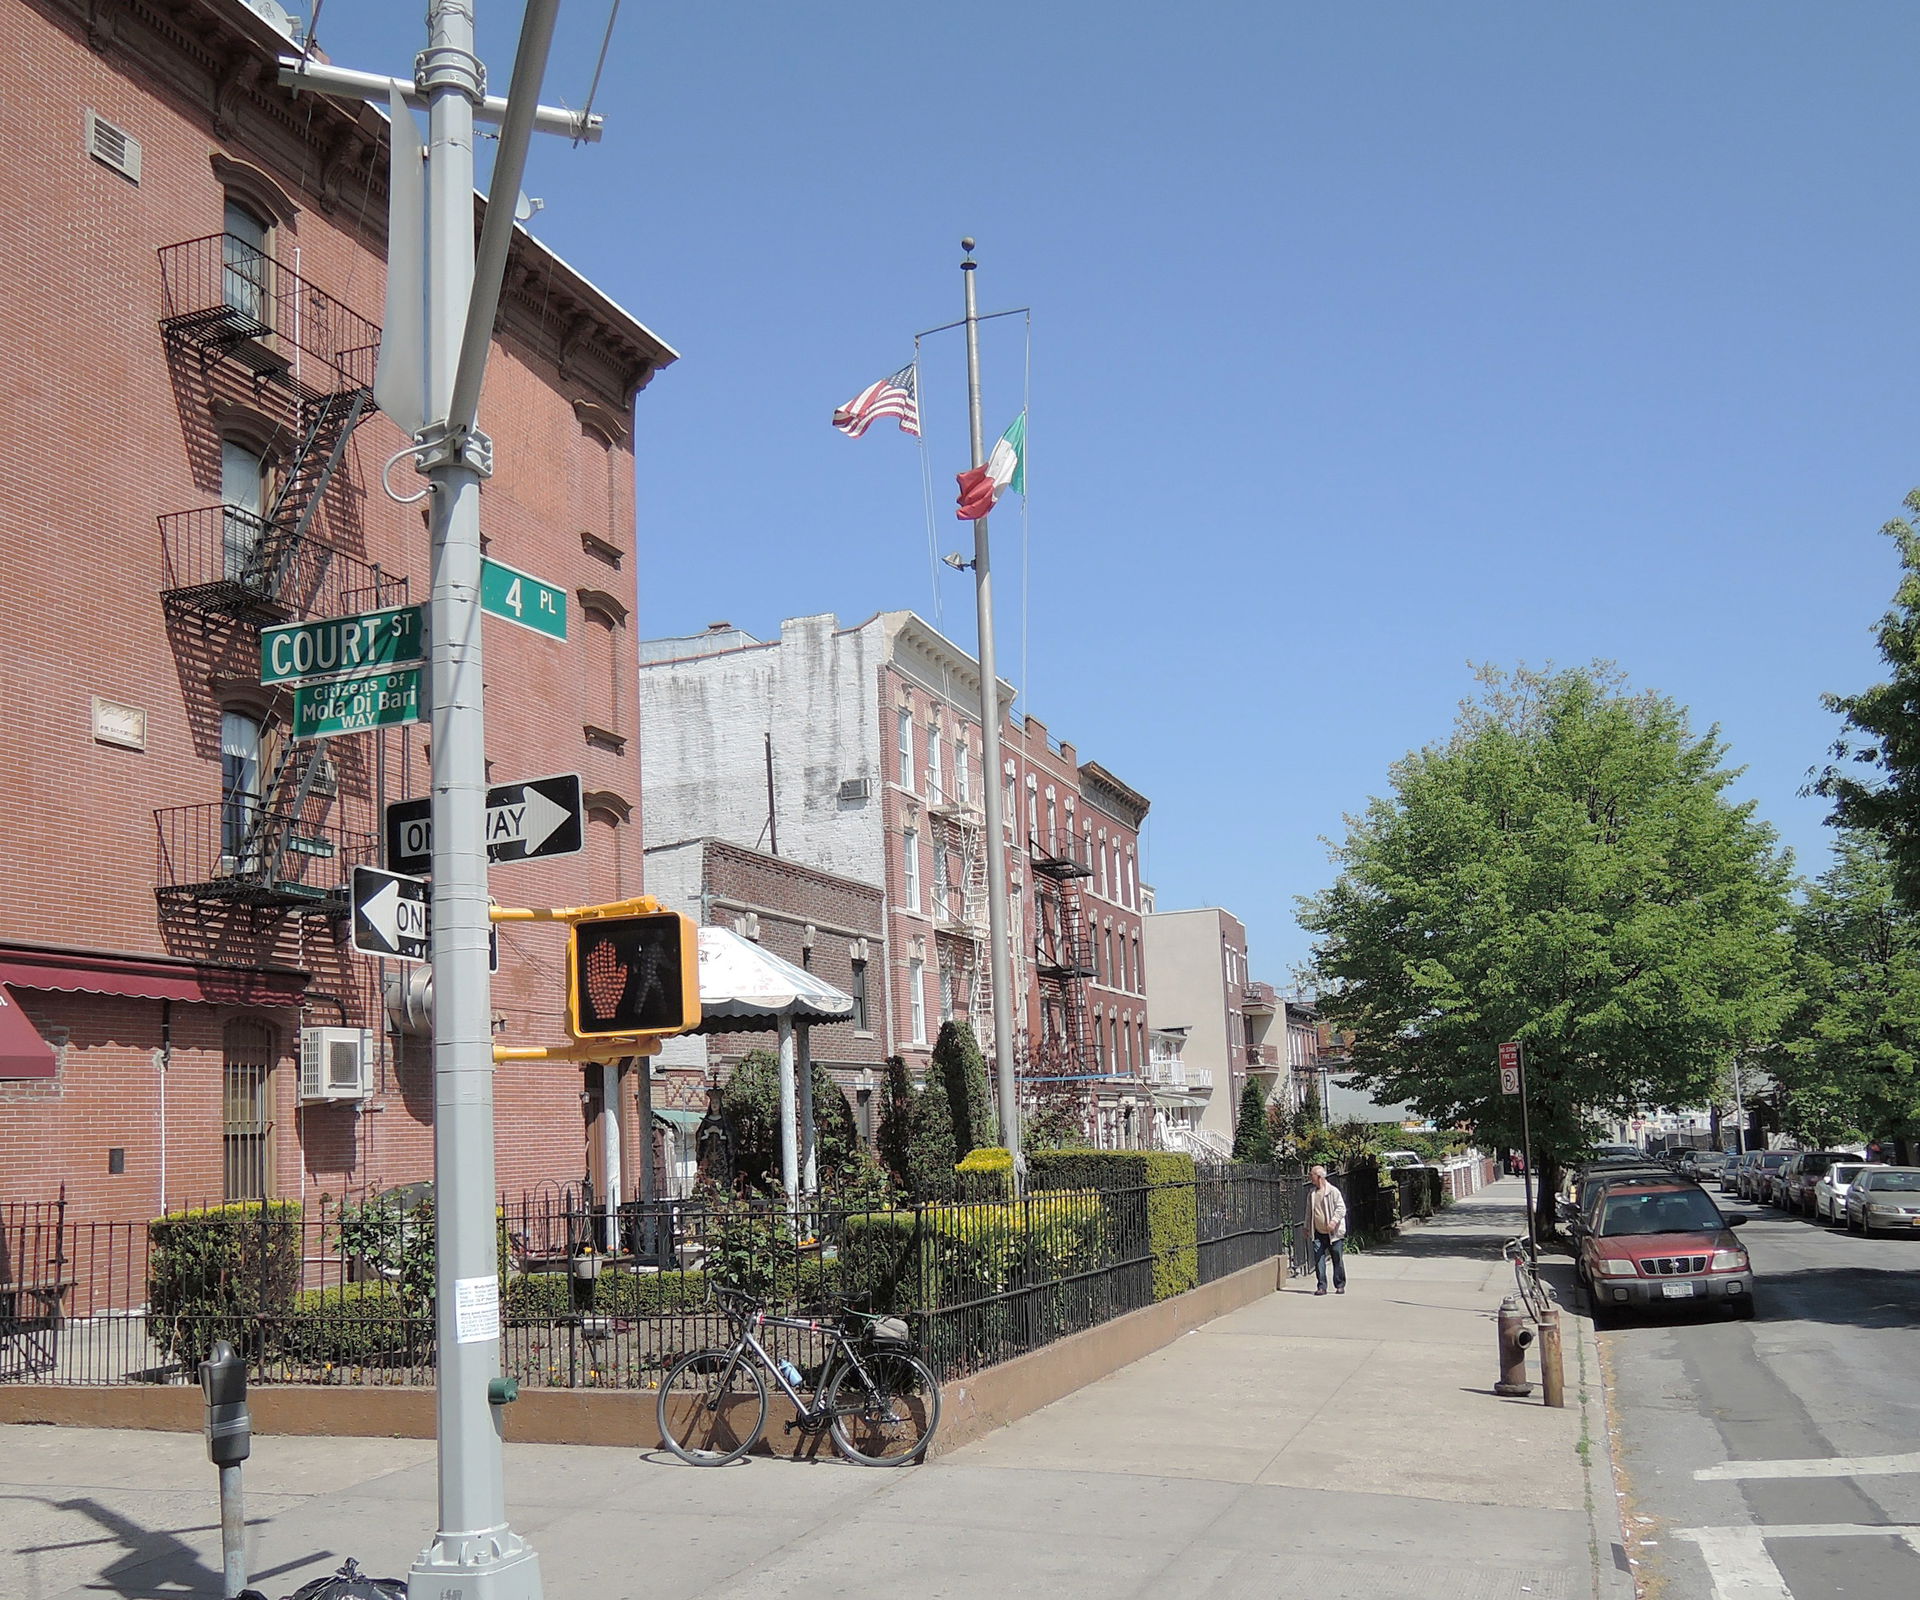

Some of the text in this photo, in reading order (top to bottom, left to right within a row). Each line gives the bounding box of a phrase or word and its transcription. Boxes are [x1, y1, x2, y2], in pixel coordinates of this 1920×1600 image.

[505, 577, 557, 617] 4 PL
[271, 613, 413, 675] COURT ST
[302, 684, 416, 723] Mola Di Bari
[314, 672, 405, 701] Citizens Of
[341, 711, 376, 729] WAY
